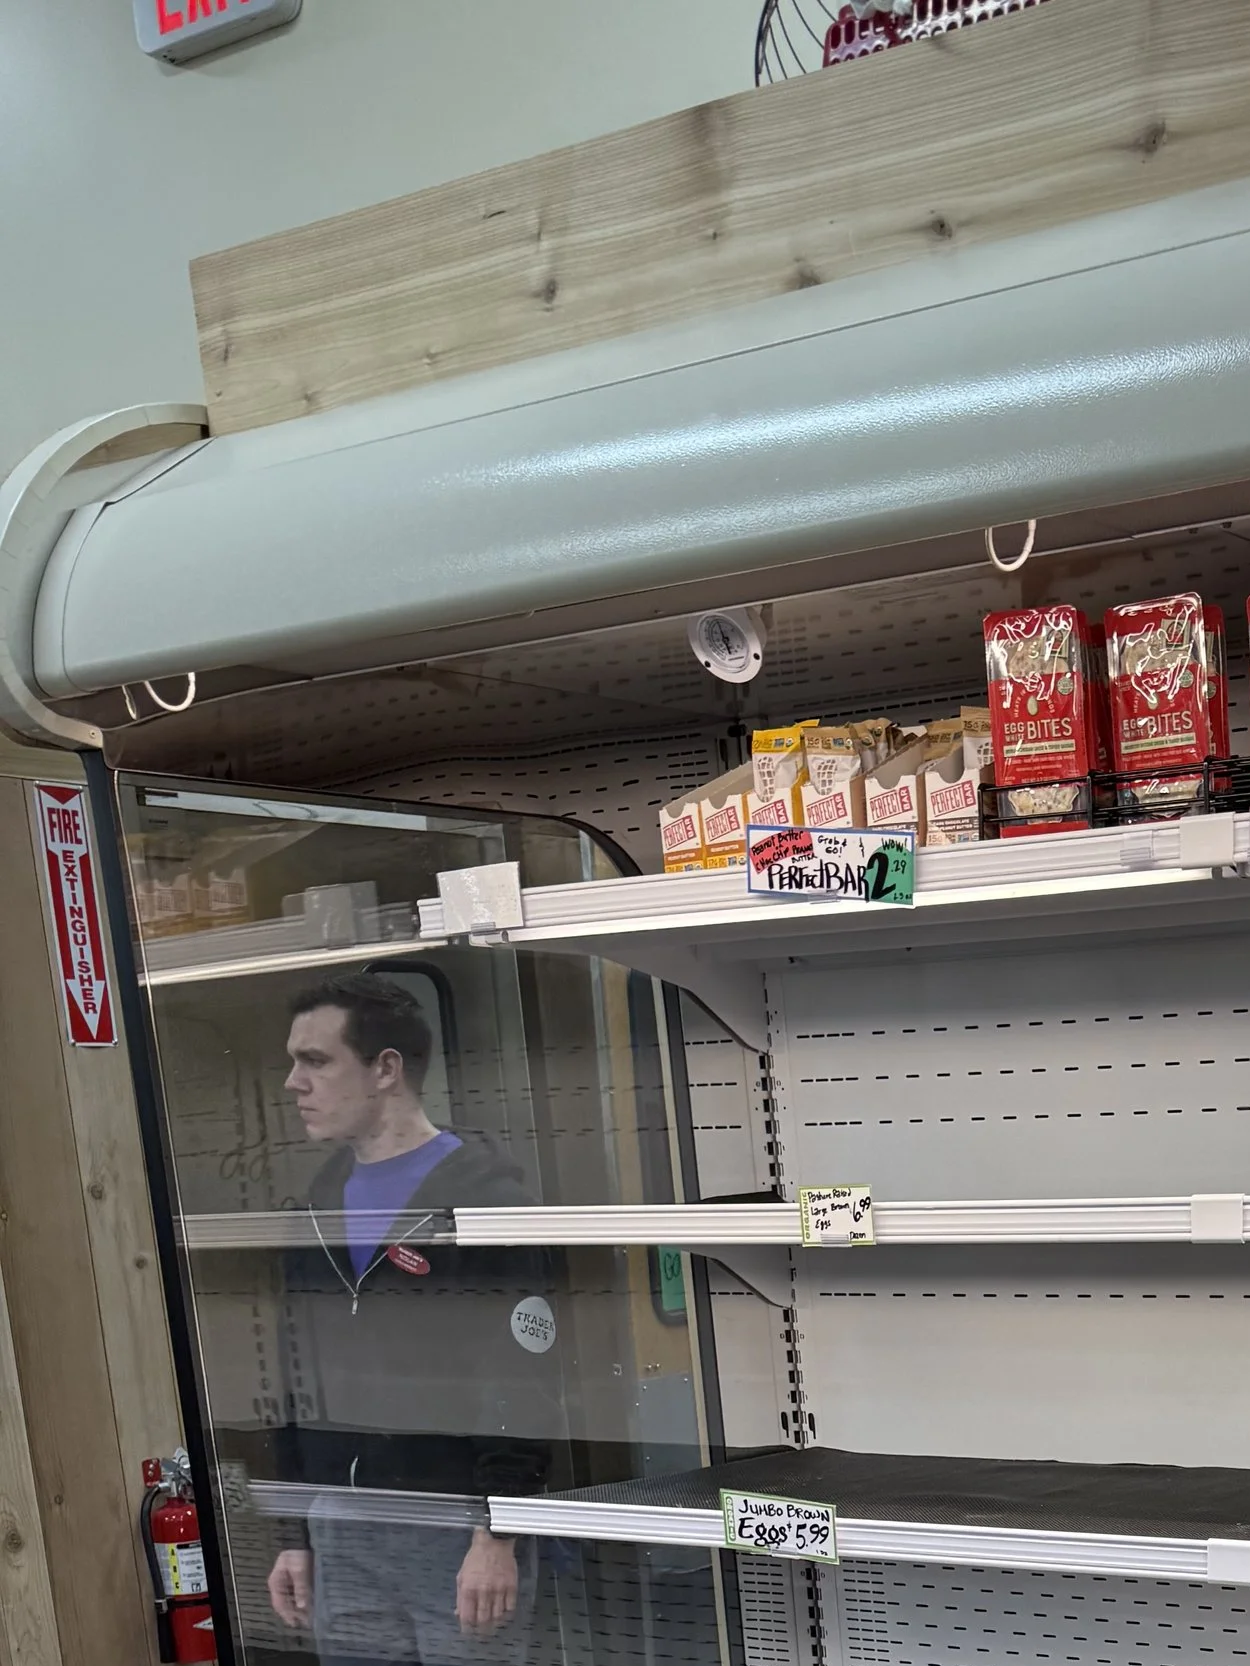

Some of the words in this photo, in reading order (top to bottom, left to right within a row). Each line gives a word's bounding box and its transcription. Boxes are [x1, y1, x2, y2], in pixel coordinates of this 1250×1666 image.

[1004, 722, 1025, 734] EGG
[1027, 717, 1073, 740] BITES
[1147, 710, 1193, 736] BITES
[807, 795, 837, 826] PERFECT
[836, 793, 846, 817] BAR
[870, 792, 902, 821] PERFECT
[901, 786, 911, 810] BAR
[931, 785, 966, 815] PERFECT
[965, 783, 975, 805] BAR
[728, 808, 738, 829] BAR
[775, 802, 787, 824] BAR
[47, 807, 83, 845] FIRE
[684, 818, 694, 839] BAR
[882, 837, 907, 857] WOW!
[62, 850, 98, 1014] EXTINGUISHER
[830, 1203, 850, 1212] Brown
[815, 1219, 831, 1231] Eggs
[517, 1311, 554, 1332] TRADER
[520, 1325, 548, 1341] JOE'S
[738, 1499, 784, 1517] JUMBO
[786, 1504, 830, 1523] BROWN
[737, 1517, 789, 1548] Eggs
